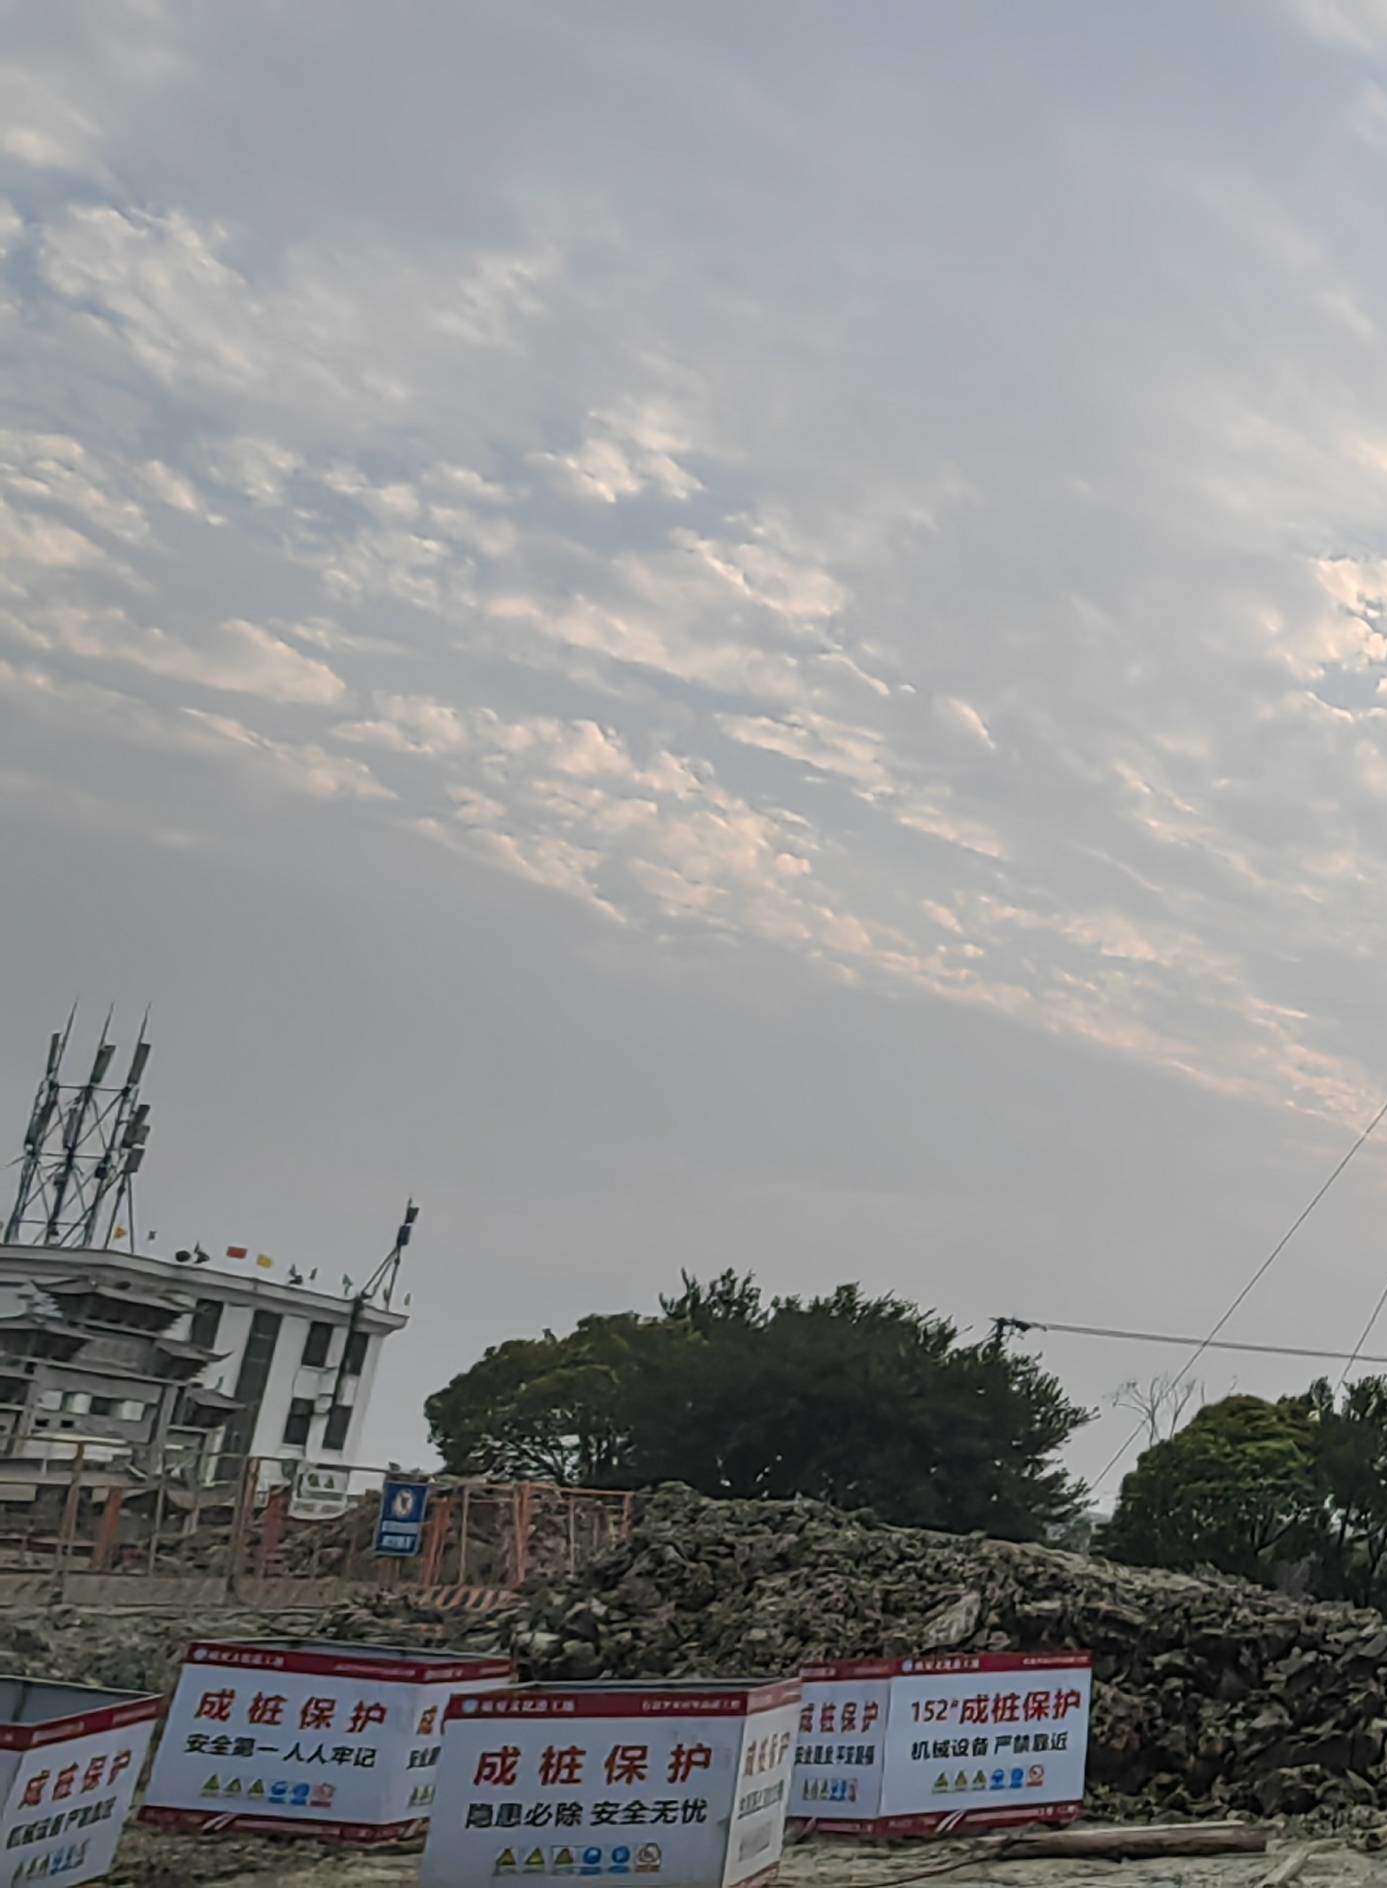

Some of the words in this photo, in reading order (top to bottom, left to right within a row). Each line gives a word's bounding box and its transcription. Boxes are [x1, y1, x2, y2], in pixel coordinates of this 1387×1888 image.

[194, 1687, 388, 1734] 成桩保护
[472, 1743, 713, 1786] 成桩保护
[911, 1736, 989, 1761] 机械设备
[589, 1798, 709, 1827] 安全无忧
